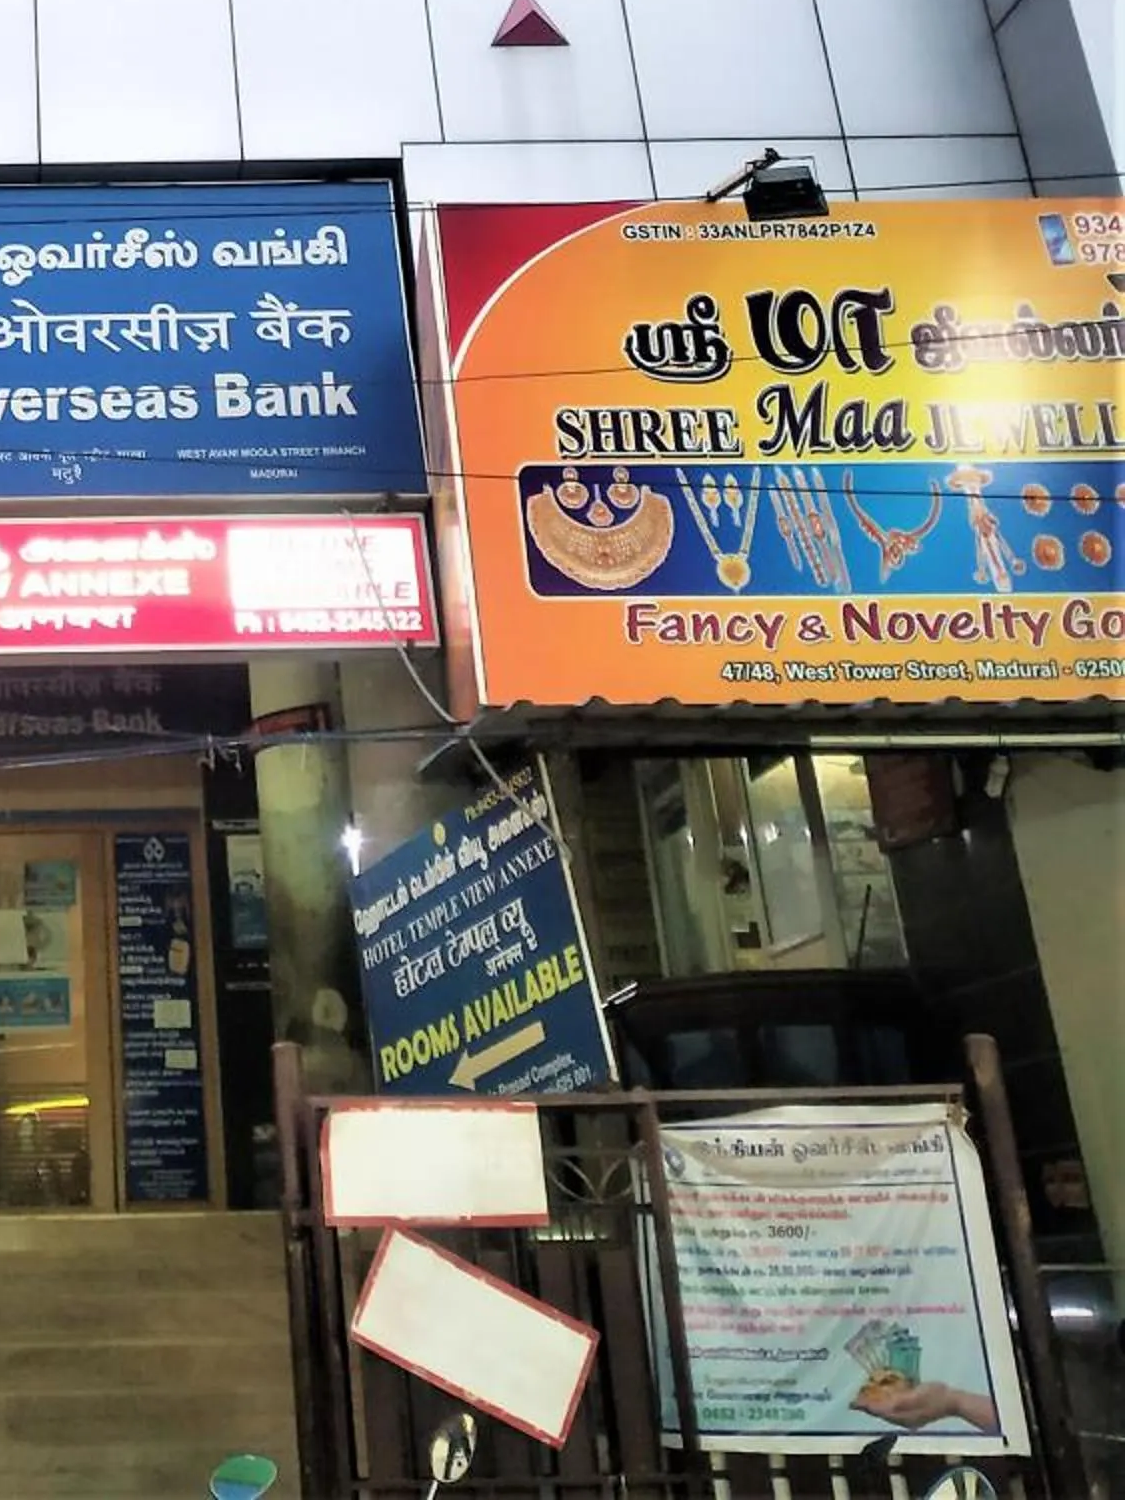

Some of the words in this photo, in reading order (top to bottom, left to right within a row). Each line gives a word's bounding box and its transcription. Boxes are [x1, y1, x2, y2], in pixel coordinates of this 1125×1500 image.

[212, 225, 348, 267] வங்கி
[623, 223, 682, 239] GSTIN
[248, 292, 353, 350] बैंक
[744, 287, 894, 374] மா
[213, 371, 358, 419] Bank
[556, 408, 741, 457] SHREE
[757, 380, 911, 454] Maa
[177, 447, 208, 460] WEST
[18, 569, 192, 596] ANNEXE
[626, 603, 785, 649] Fancy
[798, 614, 831, 642] &
[842, 602, 1052, 647] Novelty
[1062, 599, 1125, 640] Go
[721, 662, 782, 684] 47/48,
[785, 662, 836, 682] West
[839, 662, 902, 681] Tower
[906, 660, 974, 683] Street,
[977, 660, 1059, 680] Madurai
[1075, 659, 1125, 679] 6250
[91, 706, 164, 735] Bank
[363, 929, 408, 970] HOTEL
[407, 894, 462, 948] TEMPLE
[461, 874, 500, 915] VIEW
[498, 833, 557, 889] ANNEXE
[392, 946, 445, 998] होटल
[379, 1012, 461, 1083] ROOMS
[460, 944, 585, 1045] AVAILABLE
[767, 1224, 817, 1241] 3600/-
